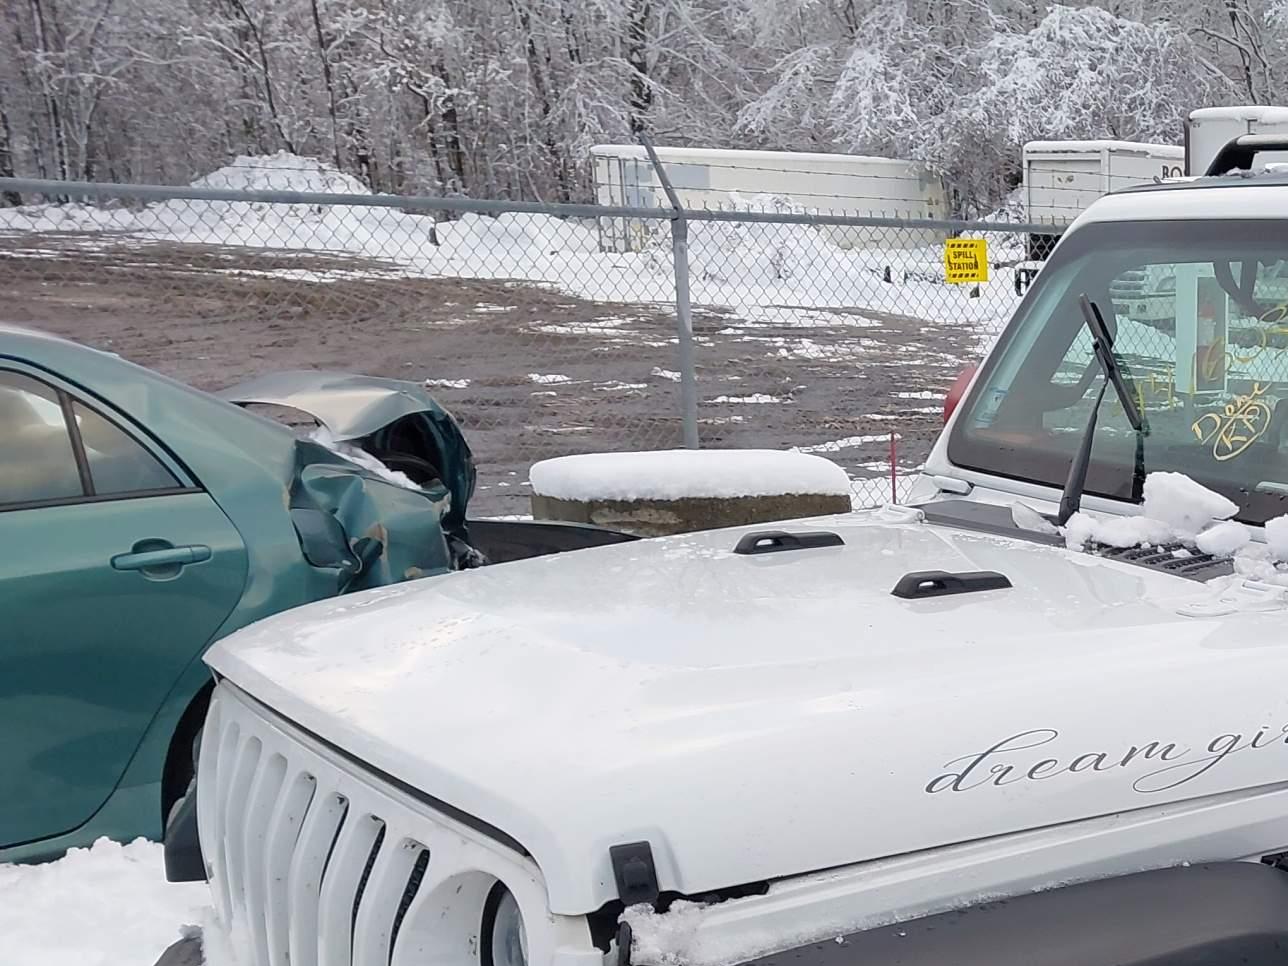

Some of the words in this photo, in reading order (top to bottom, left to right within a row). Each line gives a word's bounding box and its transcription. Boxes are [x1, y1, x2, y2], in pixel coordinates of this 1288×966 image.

[953, 251, 975, 259] SPILL
[949, 262, 979, 271] STATION
[925, 728, 1190, 794] dream
